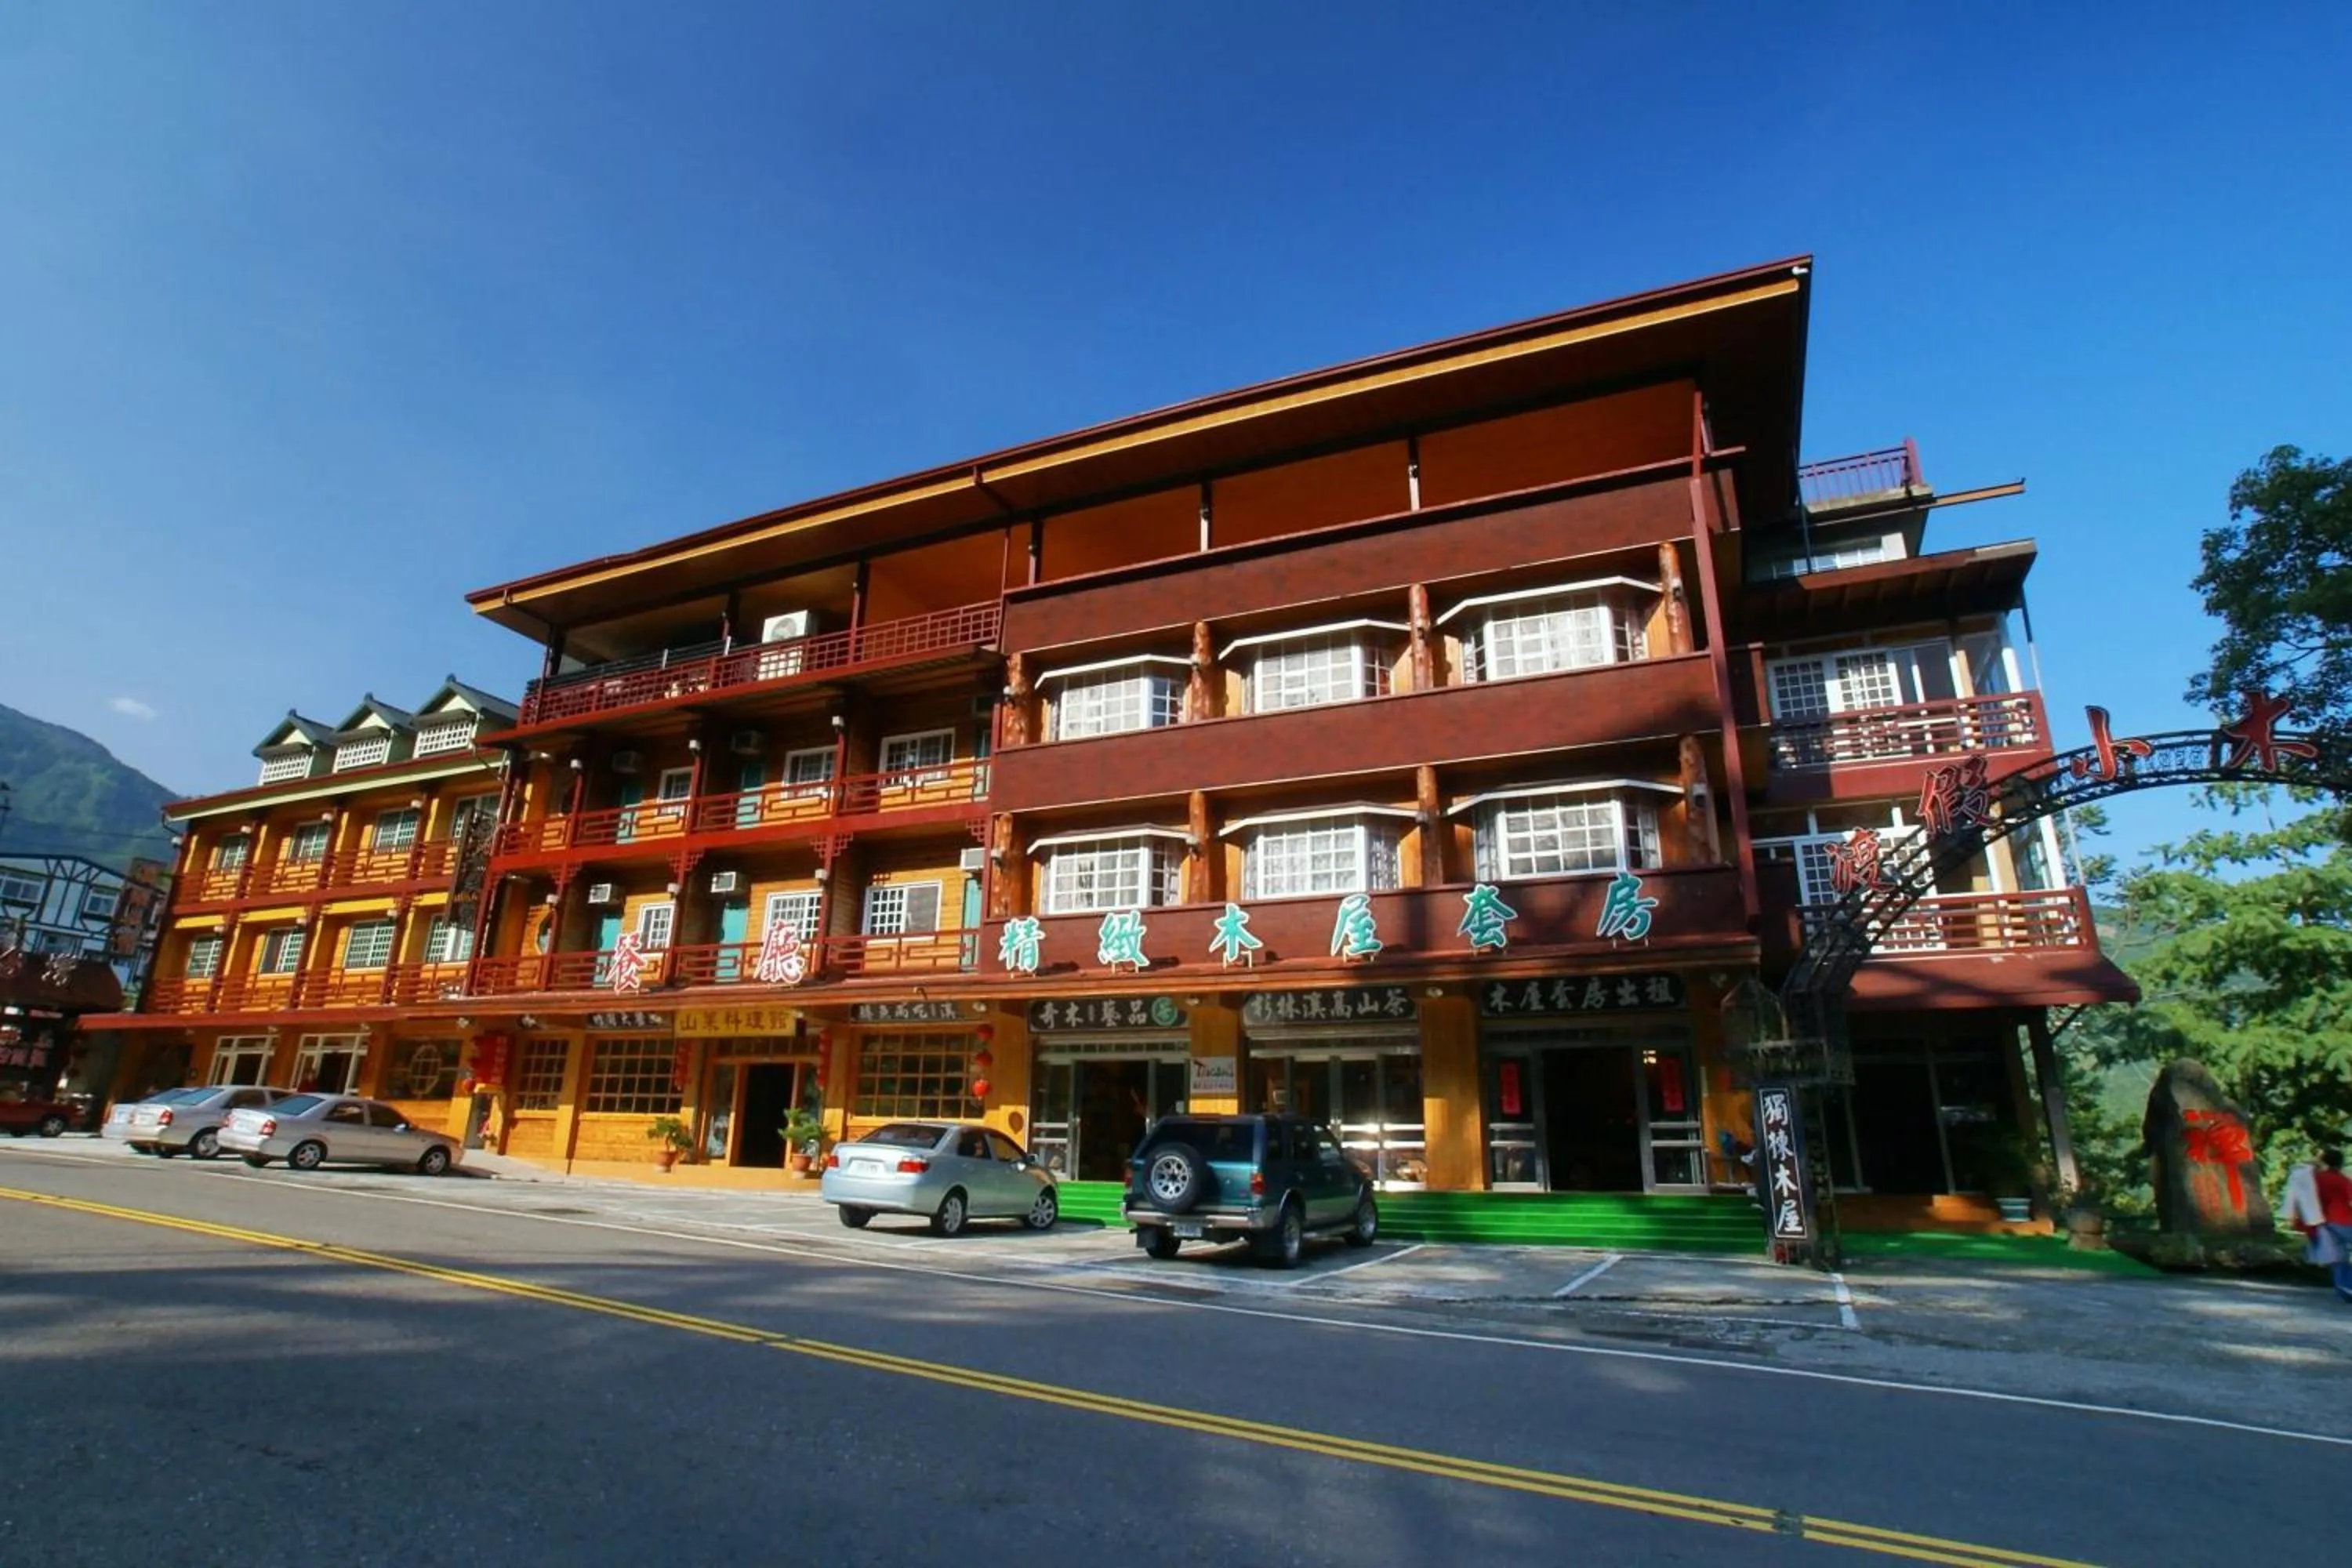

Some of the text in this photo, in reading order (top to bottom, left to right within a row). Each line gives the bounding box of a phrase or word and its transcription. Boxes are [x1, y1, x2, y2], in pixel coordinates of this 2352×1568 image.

[606, 919, 805, 994] 餐廳
[998, 872, 1659, 972] 精緻木屋套房
[1764, 1094, 1803, 1232] 獨棟木屋
